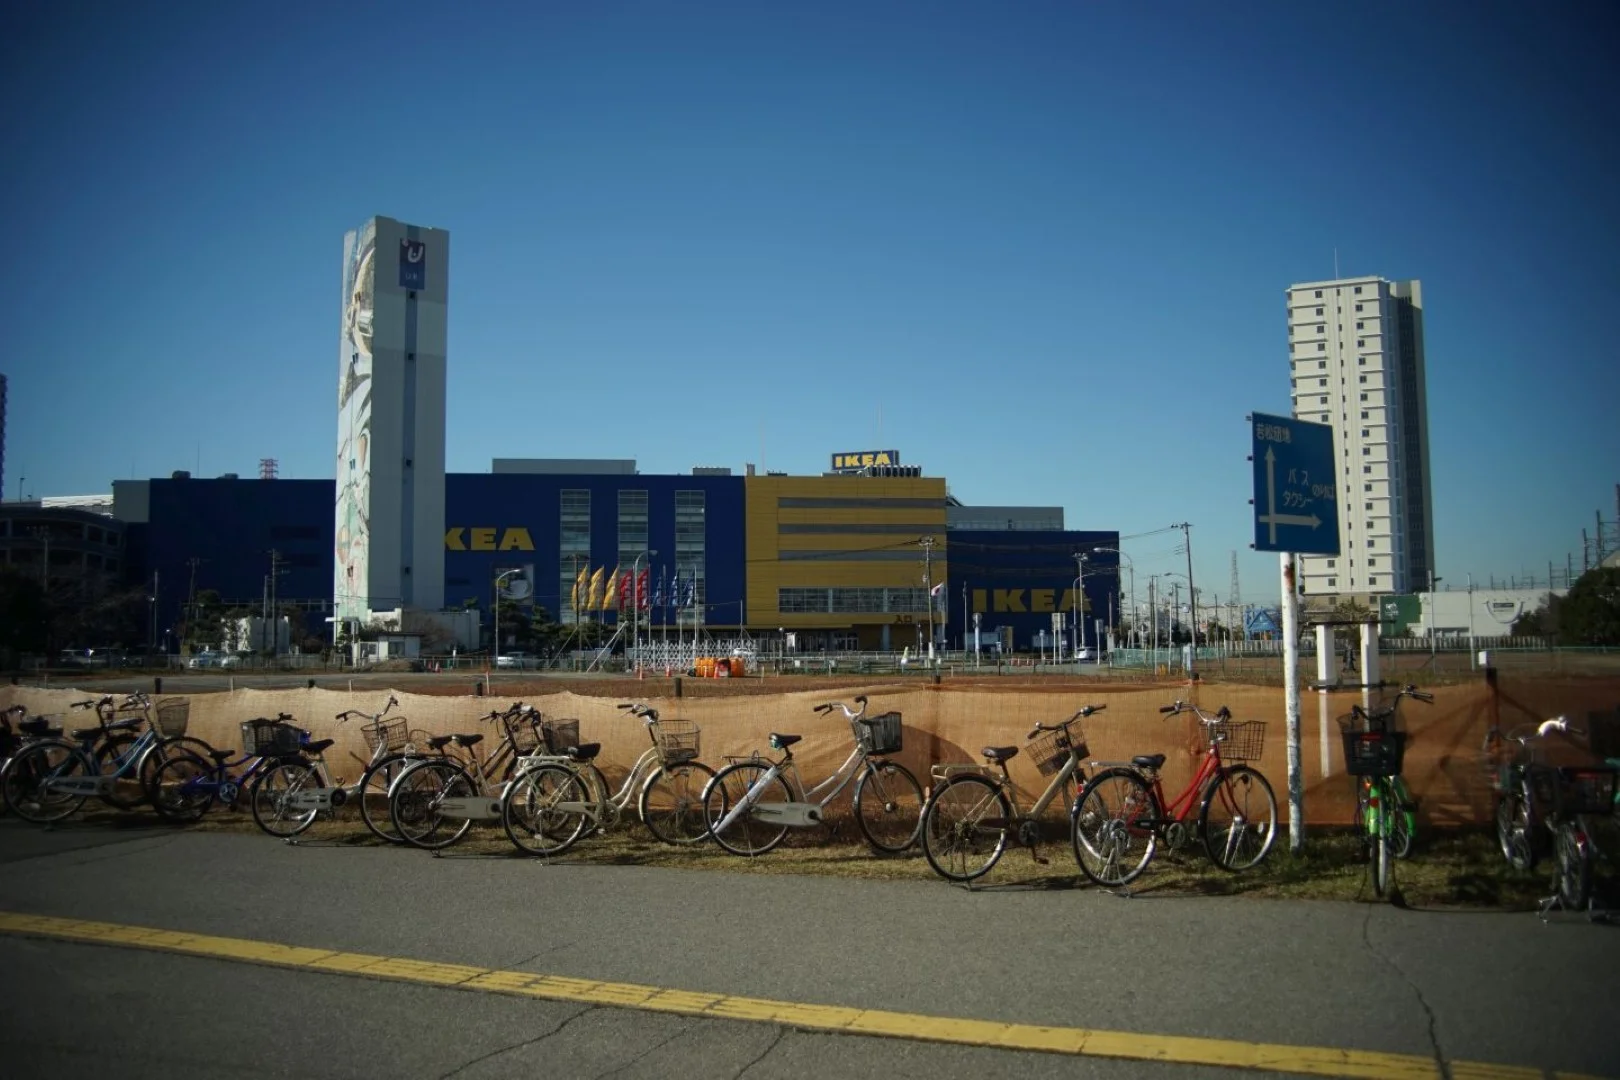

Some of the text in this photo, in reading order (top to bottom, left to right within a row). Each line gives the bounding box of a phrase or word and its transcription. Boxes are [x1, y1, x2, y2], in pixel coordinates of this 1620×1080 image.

[835, 453, 891, 468] IKEA
[1282, 489, 1313, 508] タクシー
[972, 588, 1092, 613] IKEA
